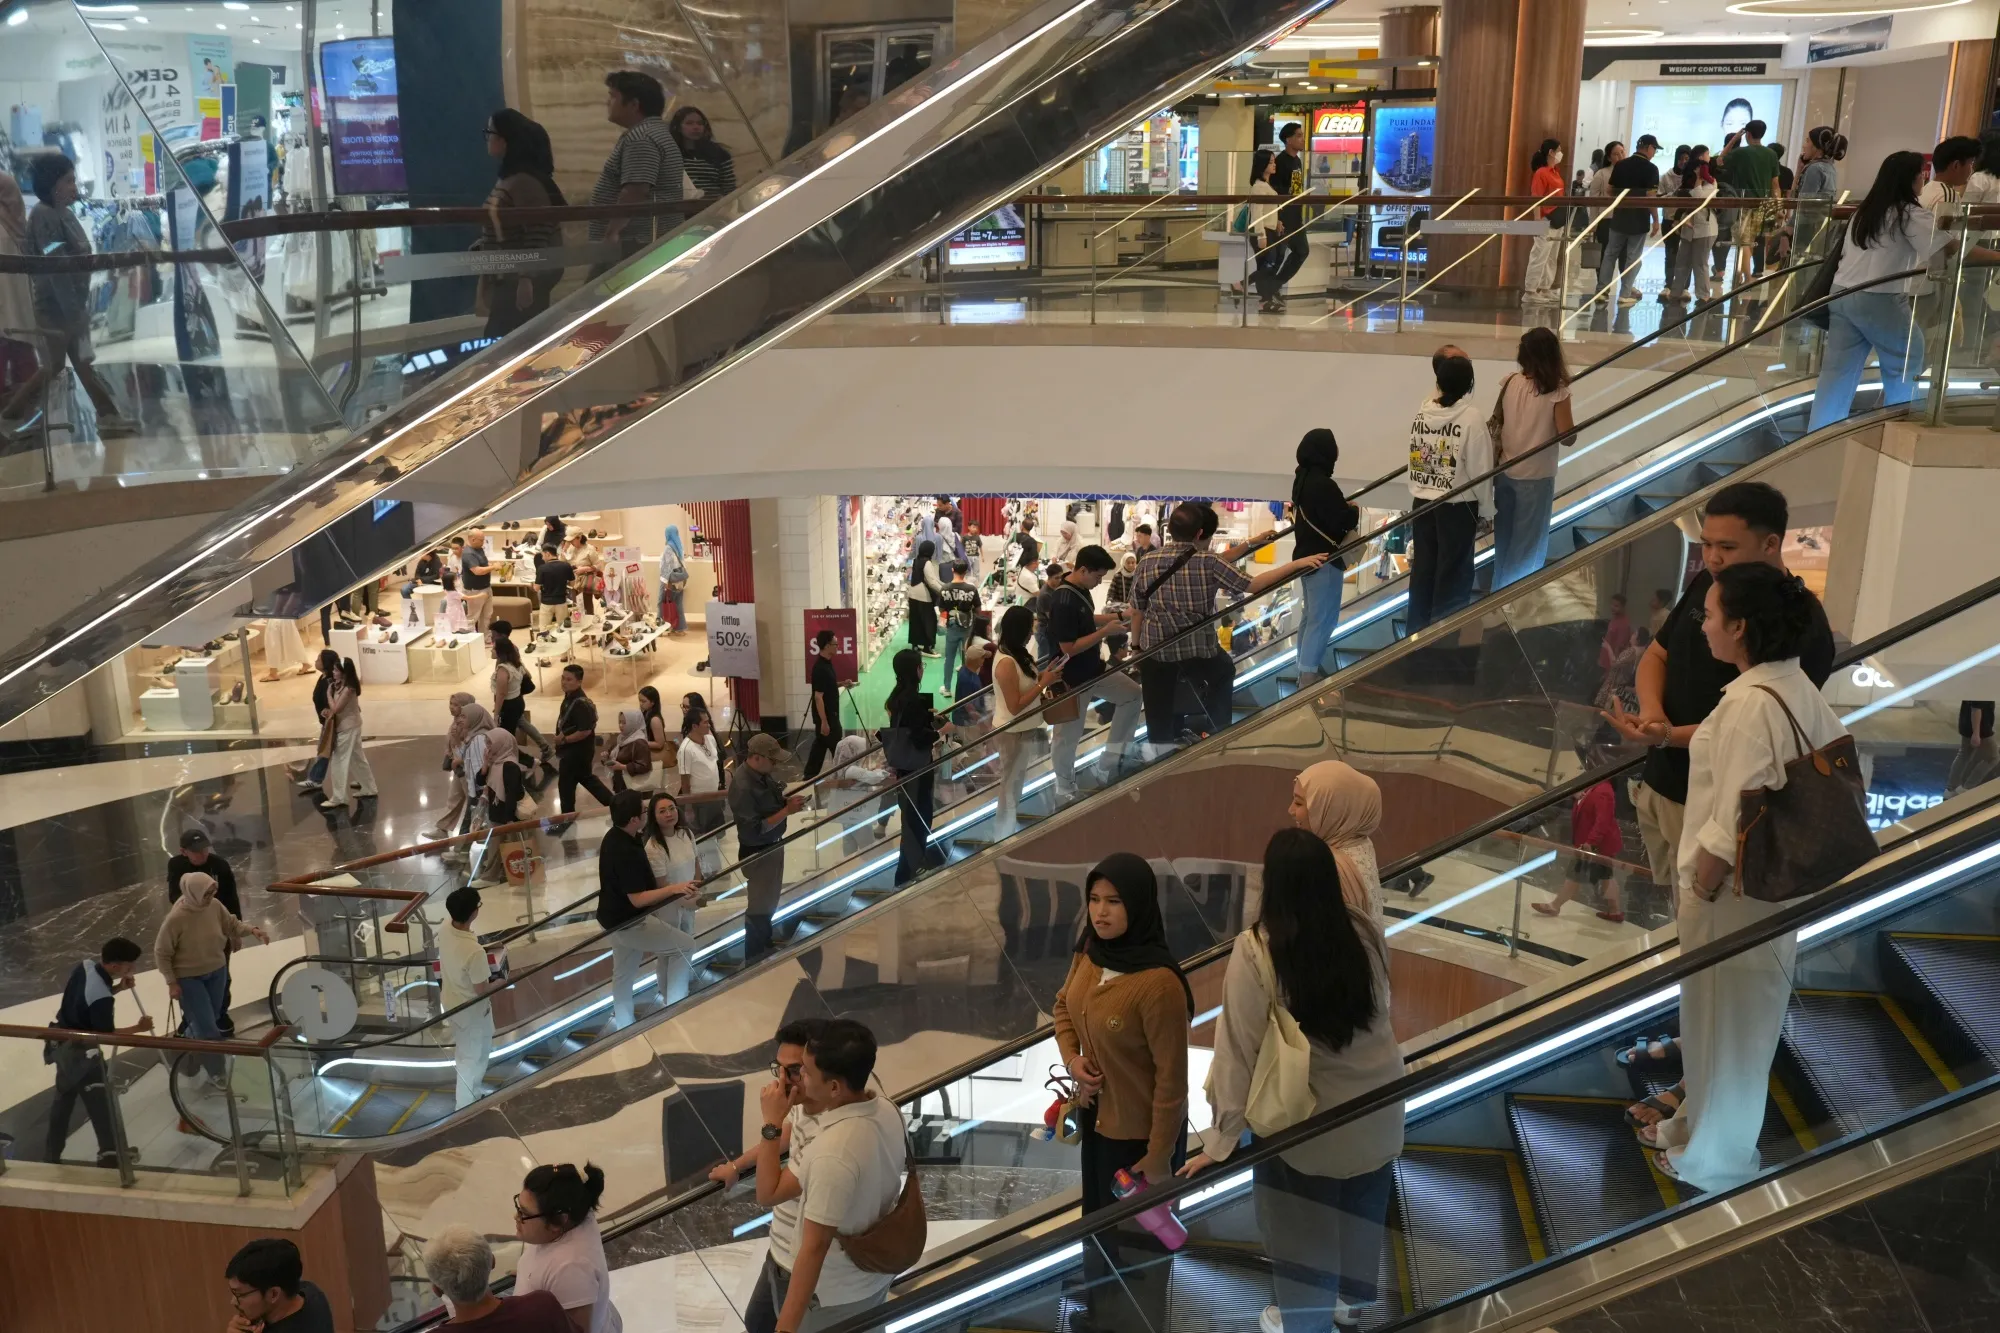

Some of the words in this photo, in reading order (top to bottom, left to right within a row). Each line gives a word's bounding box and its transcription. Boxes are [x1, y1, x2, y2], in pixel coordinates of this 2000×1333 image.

[1318, 115, 1364, 133] LEGO
[1389, 118, 1408, 126] PURI
[489, 252, 540, 262] BERSANDAR
[1410, 470, 1429, 485] NEW
[1430, 475, 1452, 490] YORK
[721, 615, 740, 627] fitflop
[716, 631, 750, 647] 50%
